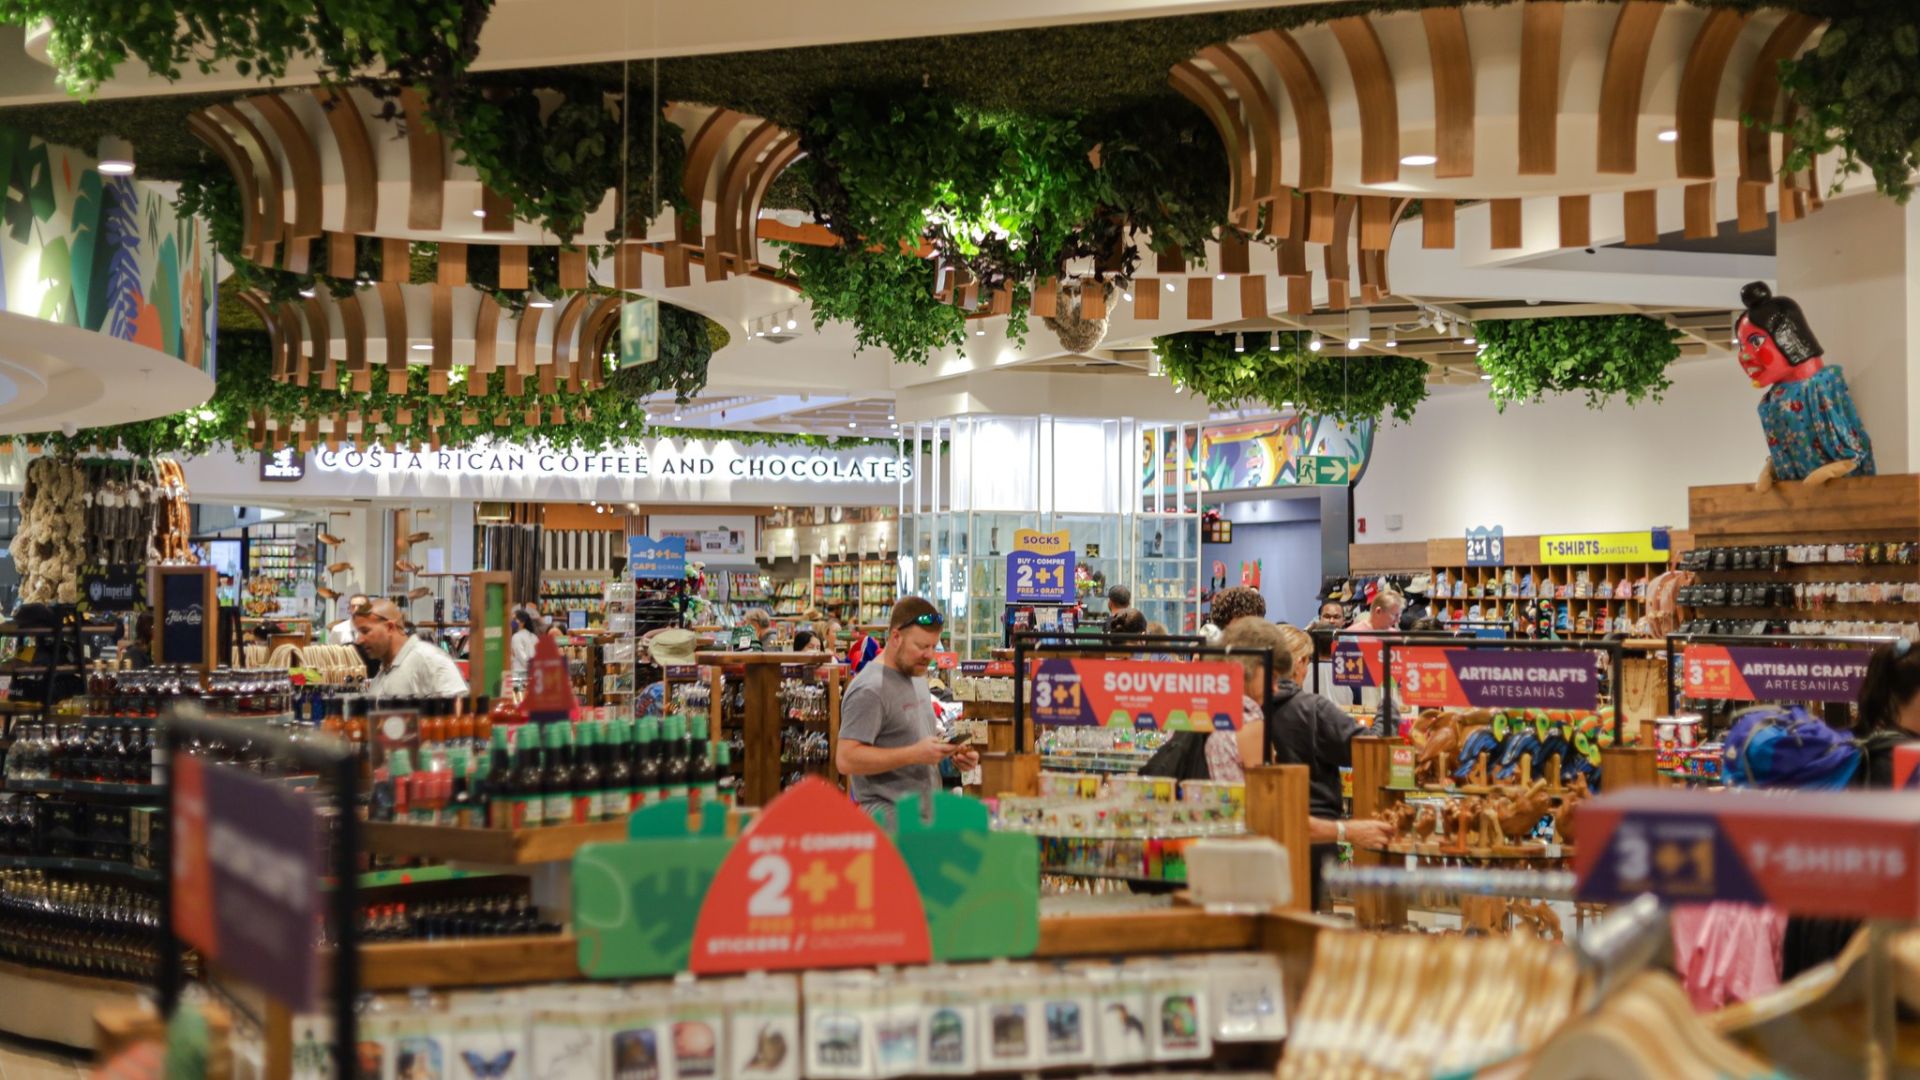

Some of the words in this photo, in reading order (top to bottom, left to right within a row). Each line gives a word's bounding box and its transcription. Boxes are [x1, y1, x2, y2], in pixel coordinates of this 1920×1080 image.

[321, 449, 422, 468] COSTA
[438, 451, 523, 471] RICAN
[539, 453, 648, 474] COFFEE
[662, 457, 714, 474] AND
[729, 458, 912, 478] CHOCOLATES
[1023, 536, 1060, 545] SOCKS
[1547, 540, 1600, 556] T-SHIRTS
[1017, 565, 1064, 587] 2+1
[103, 584, 132, 599] Imperial
[1334, 656, 1364, 674] 3+1
[1742, 663, 1808, 677] ARTISAN
[1103, 671, 1231, 695] SOUVENIRS
[1406, 669, 1448, 692] 3+1
[1459, 667, 1524, 682] ARTISAN
[1526, 667, 1588, 683] CRAFTS
[1689, 665, 1730, 686] 3+1
[1765, 678, 1850, 691] ARTESANÍAS
[1036, 681, 1081, 708] 3+1
[1481, 683, 1565, 698] ARTESANÍAS
[1752, 844, 1906, 877] T-SHIRTS
[748, 852, 874, 917] 2+1
